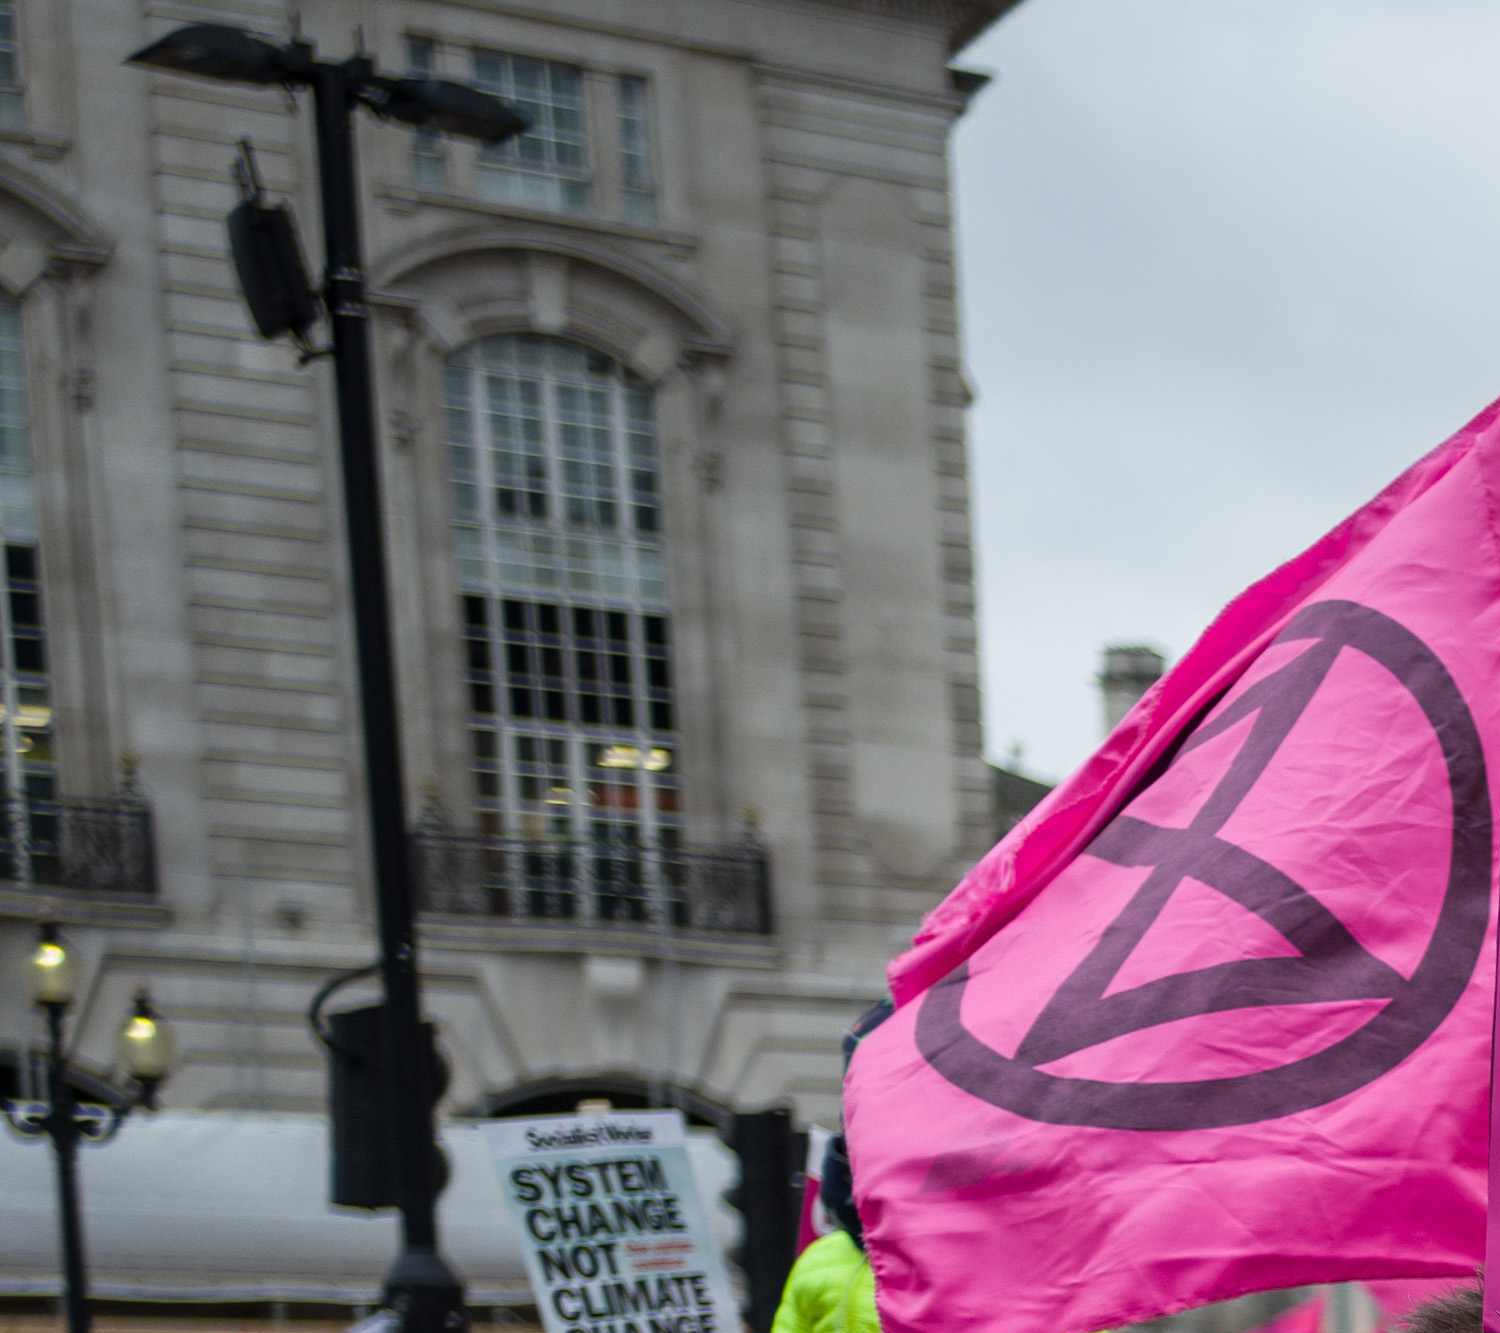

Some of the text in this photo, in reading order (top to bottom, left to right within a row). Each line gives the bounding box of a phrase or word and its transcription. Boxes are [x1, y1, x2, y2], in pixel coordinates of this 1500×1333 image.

[511, 1159, 668, 1201] SYSTEM
[525, 1197, 687, 1242] CHANGE
[538, 1243, 620, 1282] NOT
[553, 1274, 712, 1321] CLIMATE
